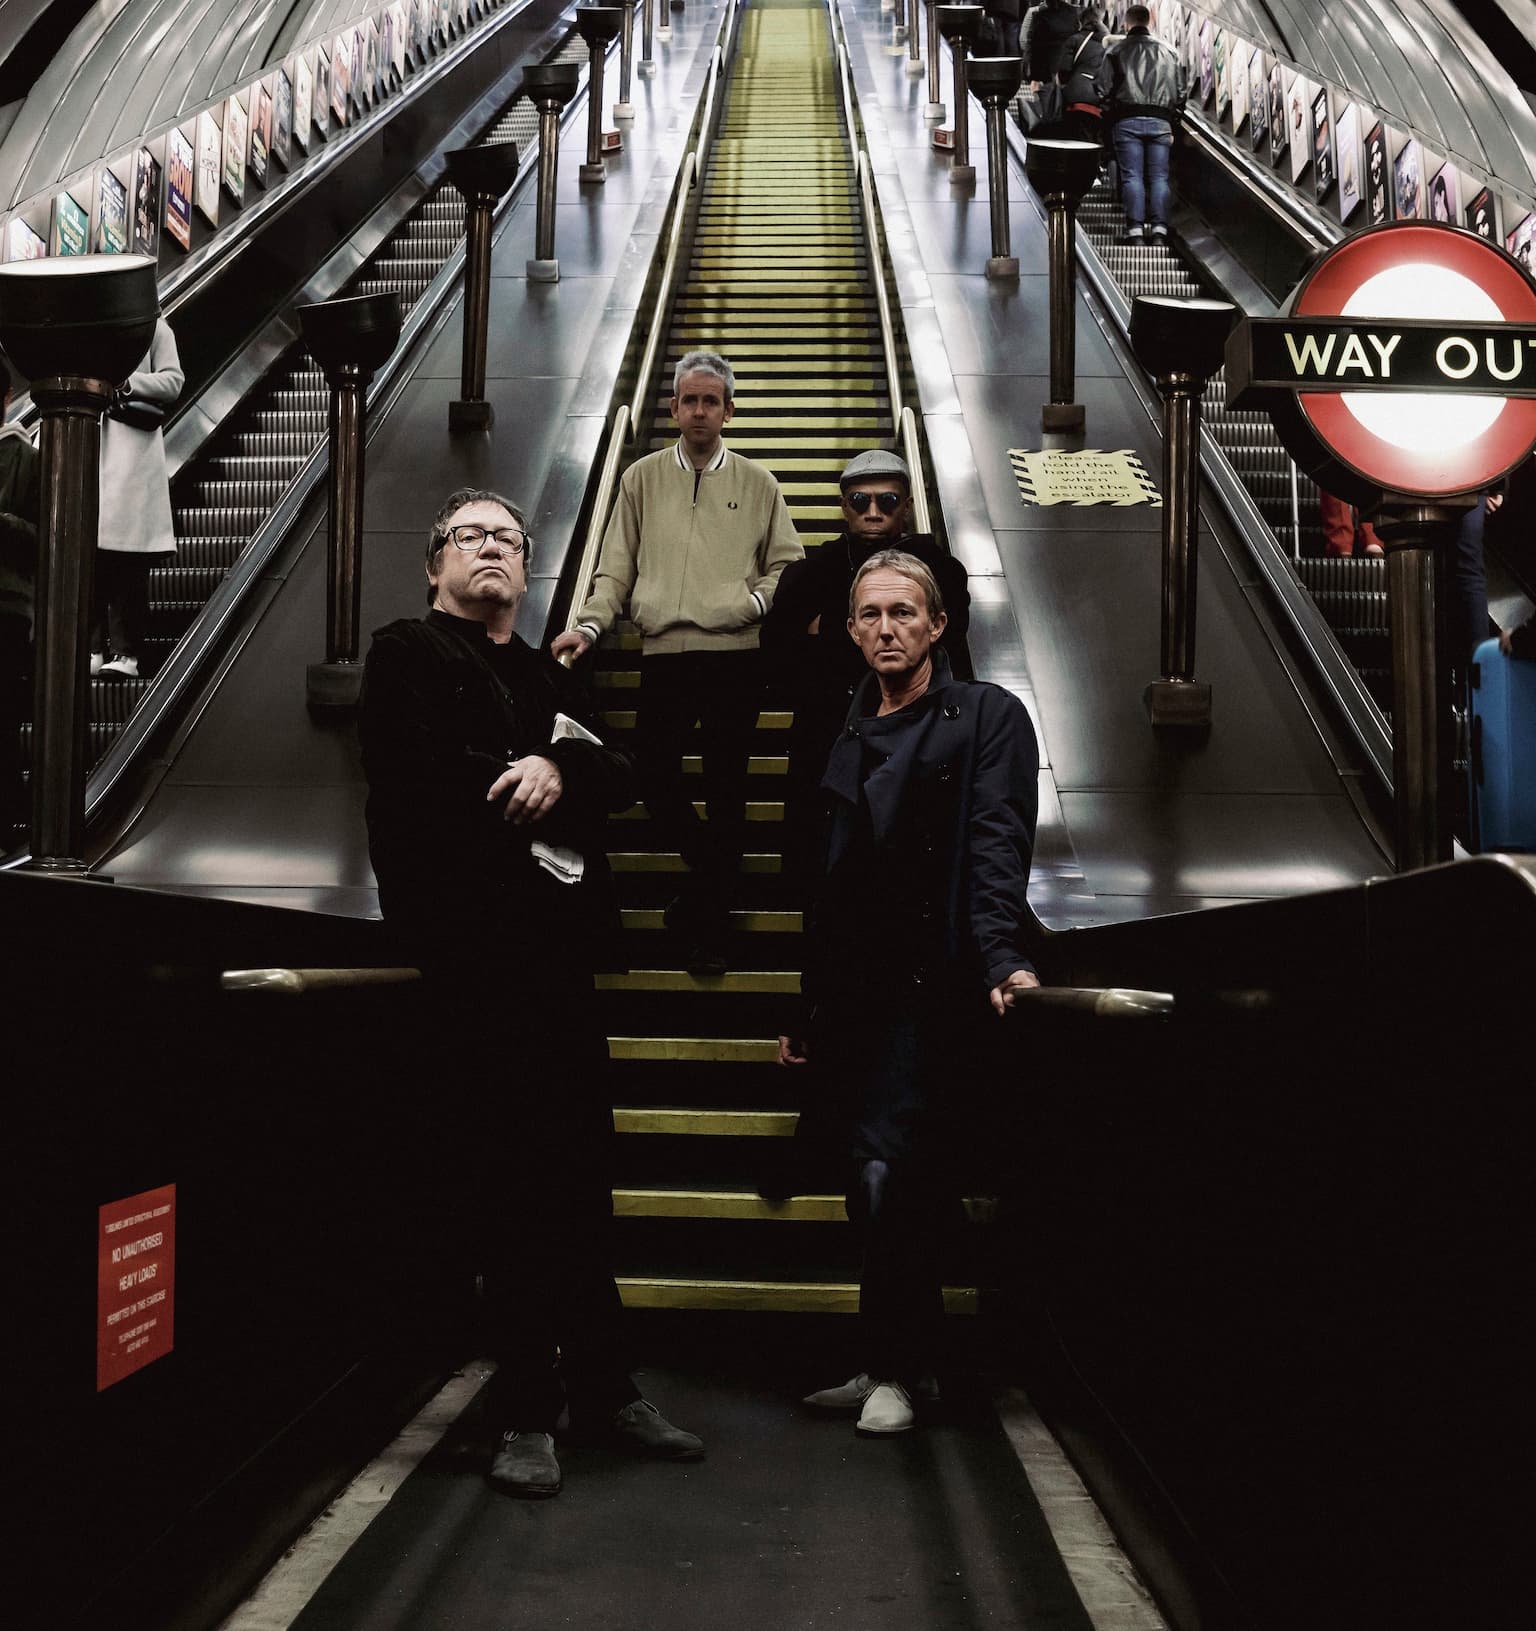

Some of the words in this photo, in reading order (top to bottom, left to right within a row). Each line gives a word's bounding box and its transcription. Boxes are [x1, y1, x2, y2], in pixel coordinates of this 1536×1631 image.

[1284, 333, 1401, 377] WAY
[1436, 336, 1536, 381] OU
[112, 1247, 121, 1264] NO
[122, 1231, 163, 1260] UNAUTHORISED
[119, 1271, 138, 1291] HEAVY
